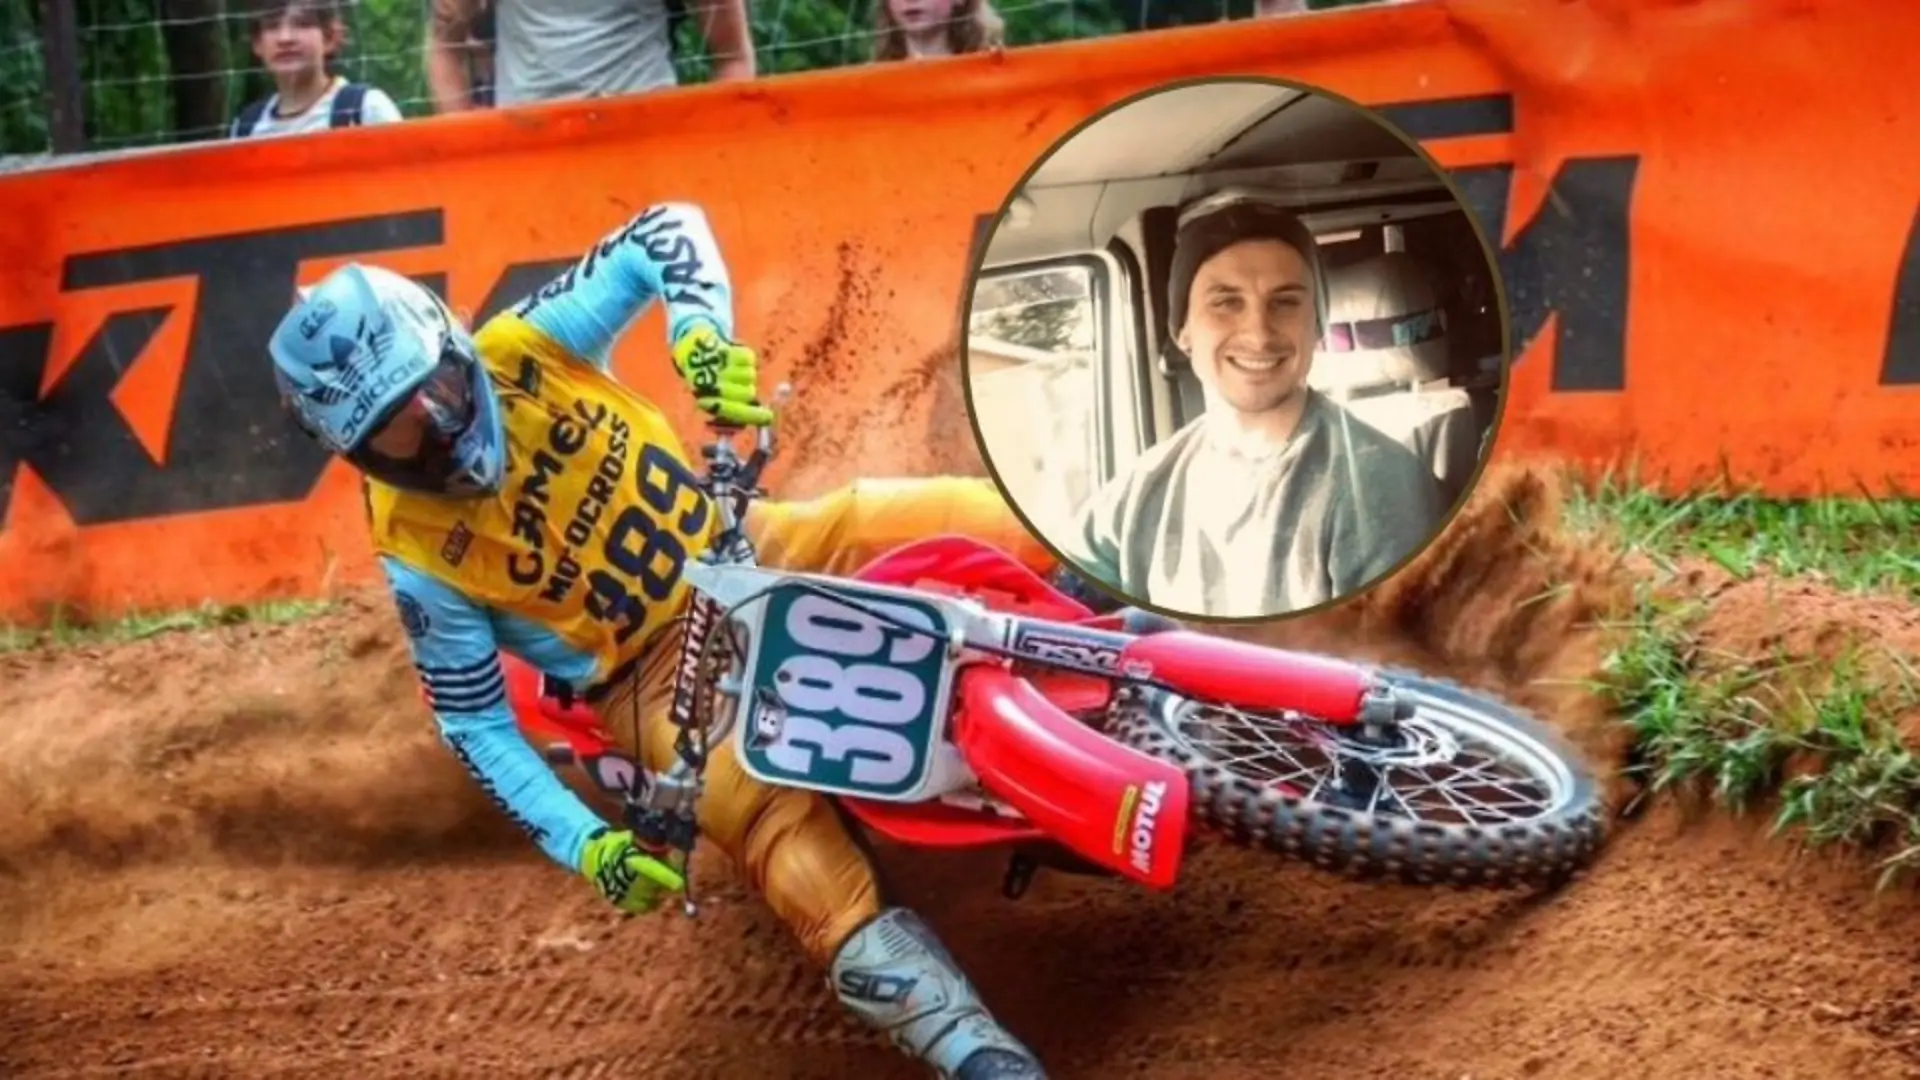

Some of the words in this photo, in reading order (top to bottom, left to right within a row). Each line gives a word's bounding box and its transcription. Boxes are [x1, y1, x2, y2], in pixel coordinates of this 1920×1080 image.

[0, 208, 590, 528] KT
[340, 352, 428, 446] adidas
[507, 398, 607, 586] CAMEL
[539, 413, 630, 604] MOOCROSS
[764, 593, 936, 786] 389
[1129, 780, 1167, 874] MOTUL
